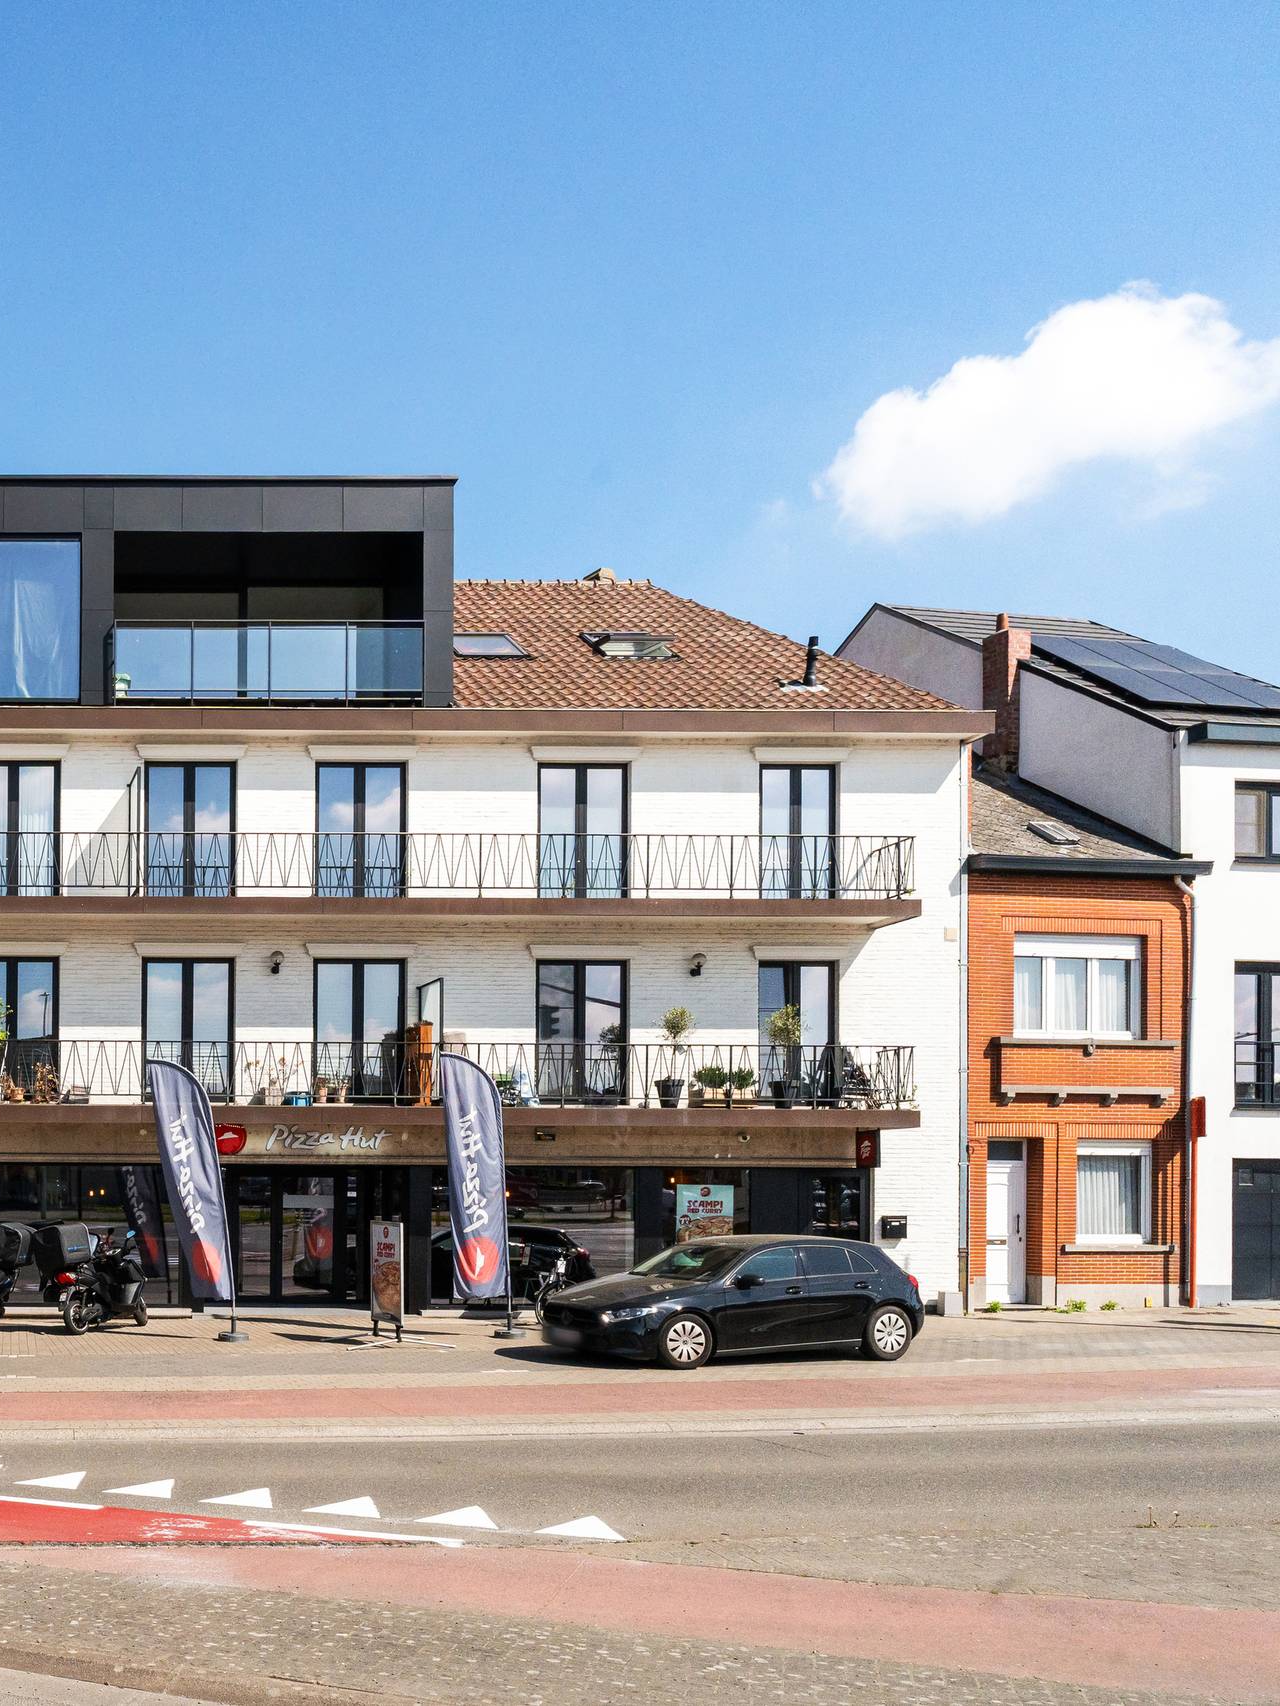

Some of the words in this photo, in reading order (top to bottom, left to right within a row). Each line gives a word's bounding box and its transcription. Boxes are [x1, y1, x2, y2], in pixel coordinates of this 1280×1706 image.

[266, 1124, 336, 1151] Pizza
[339, 1125, 393, 1151] Hut
[687, 1200, 724, 1208] SCAMPI
[377, 1241, 396, 1252] SCAMPI
